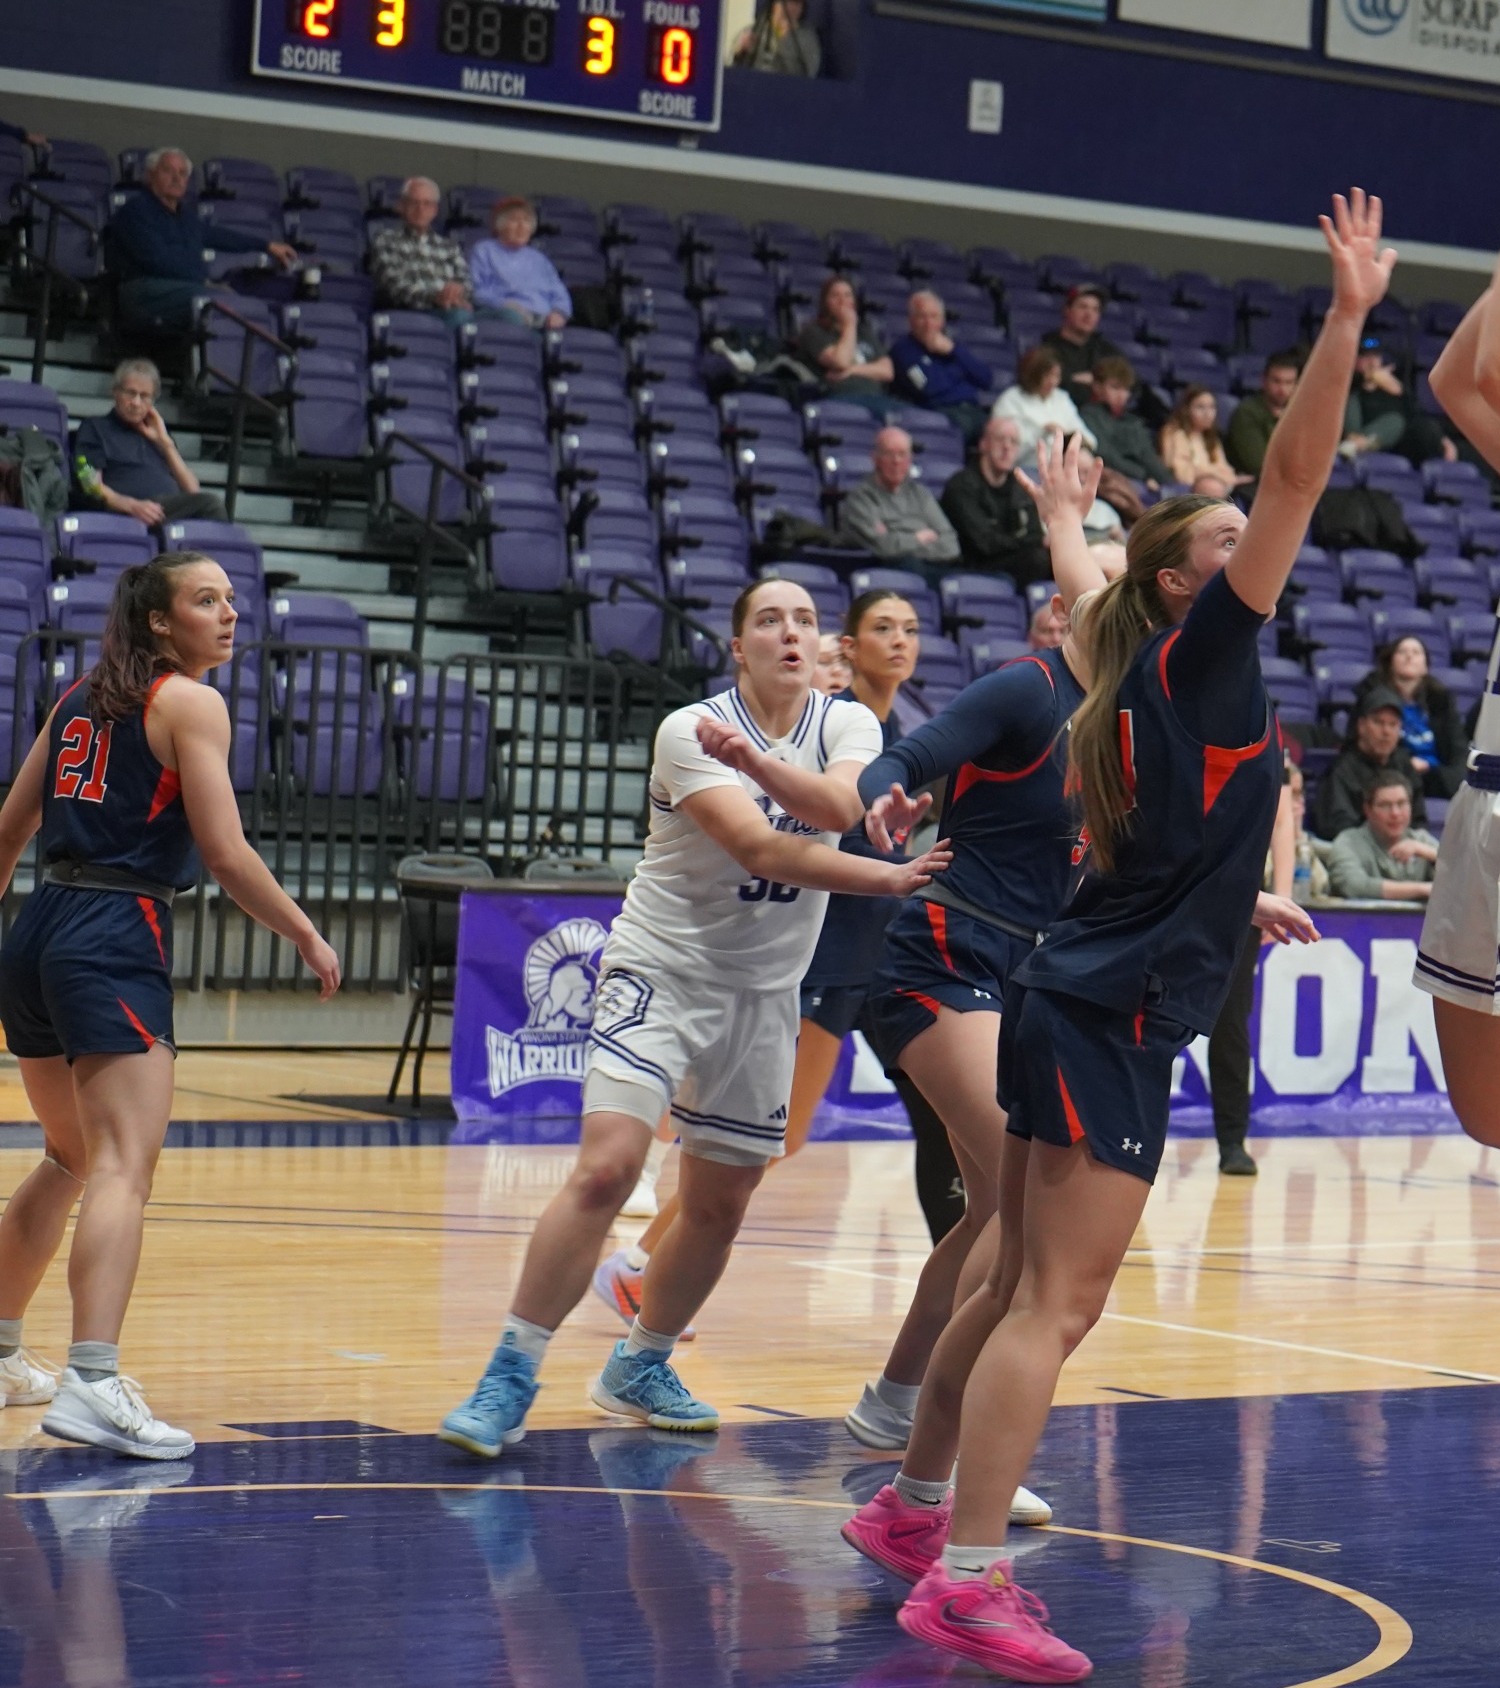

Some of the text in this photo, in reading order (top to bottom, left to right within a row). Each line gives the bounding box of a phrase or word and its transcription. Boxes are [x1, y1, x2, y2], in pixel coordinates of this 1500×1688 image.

[643, 2, 700, 29] FOULS
[280, 43, 343, 75] SCORE
[585, 17, 615, 75] 3
[660, 28, 692, 85] 0
[461, 67, 526, 97] MATCH
[638, 89, 697, 119] SCORE
[54, 717, 114, 803] 21
[488, 1027, 592, 1094] WARRIO
